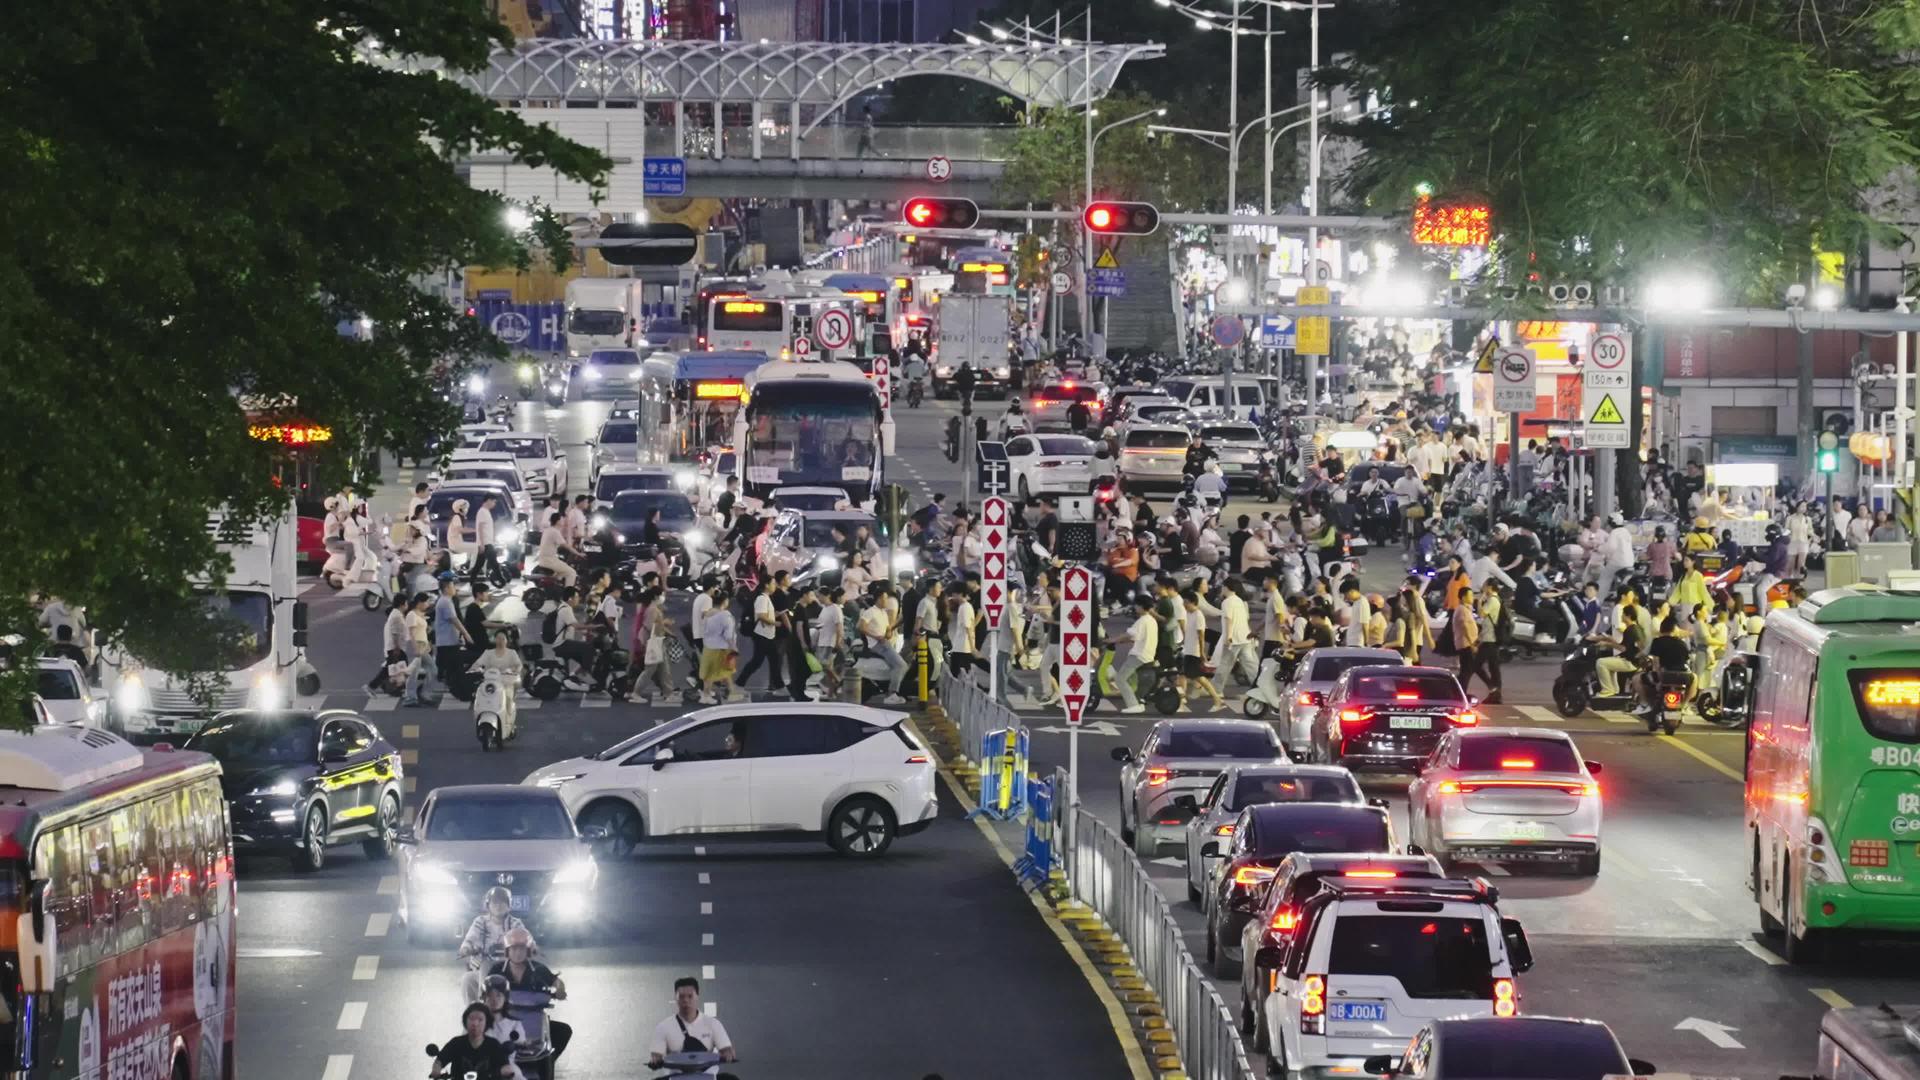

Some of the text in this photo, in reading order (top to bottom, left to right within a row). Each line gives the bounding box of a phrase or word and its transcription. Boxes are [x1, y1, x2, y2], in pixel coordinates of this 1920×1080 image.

[643, 162, 682, 177] 学天桥
[1600, 344, 1618, 360] 30
[108, 960, 161, 1037] 所有农夫山泉
